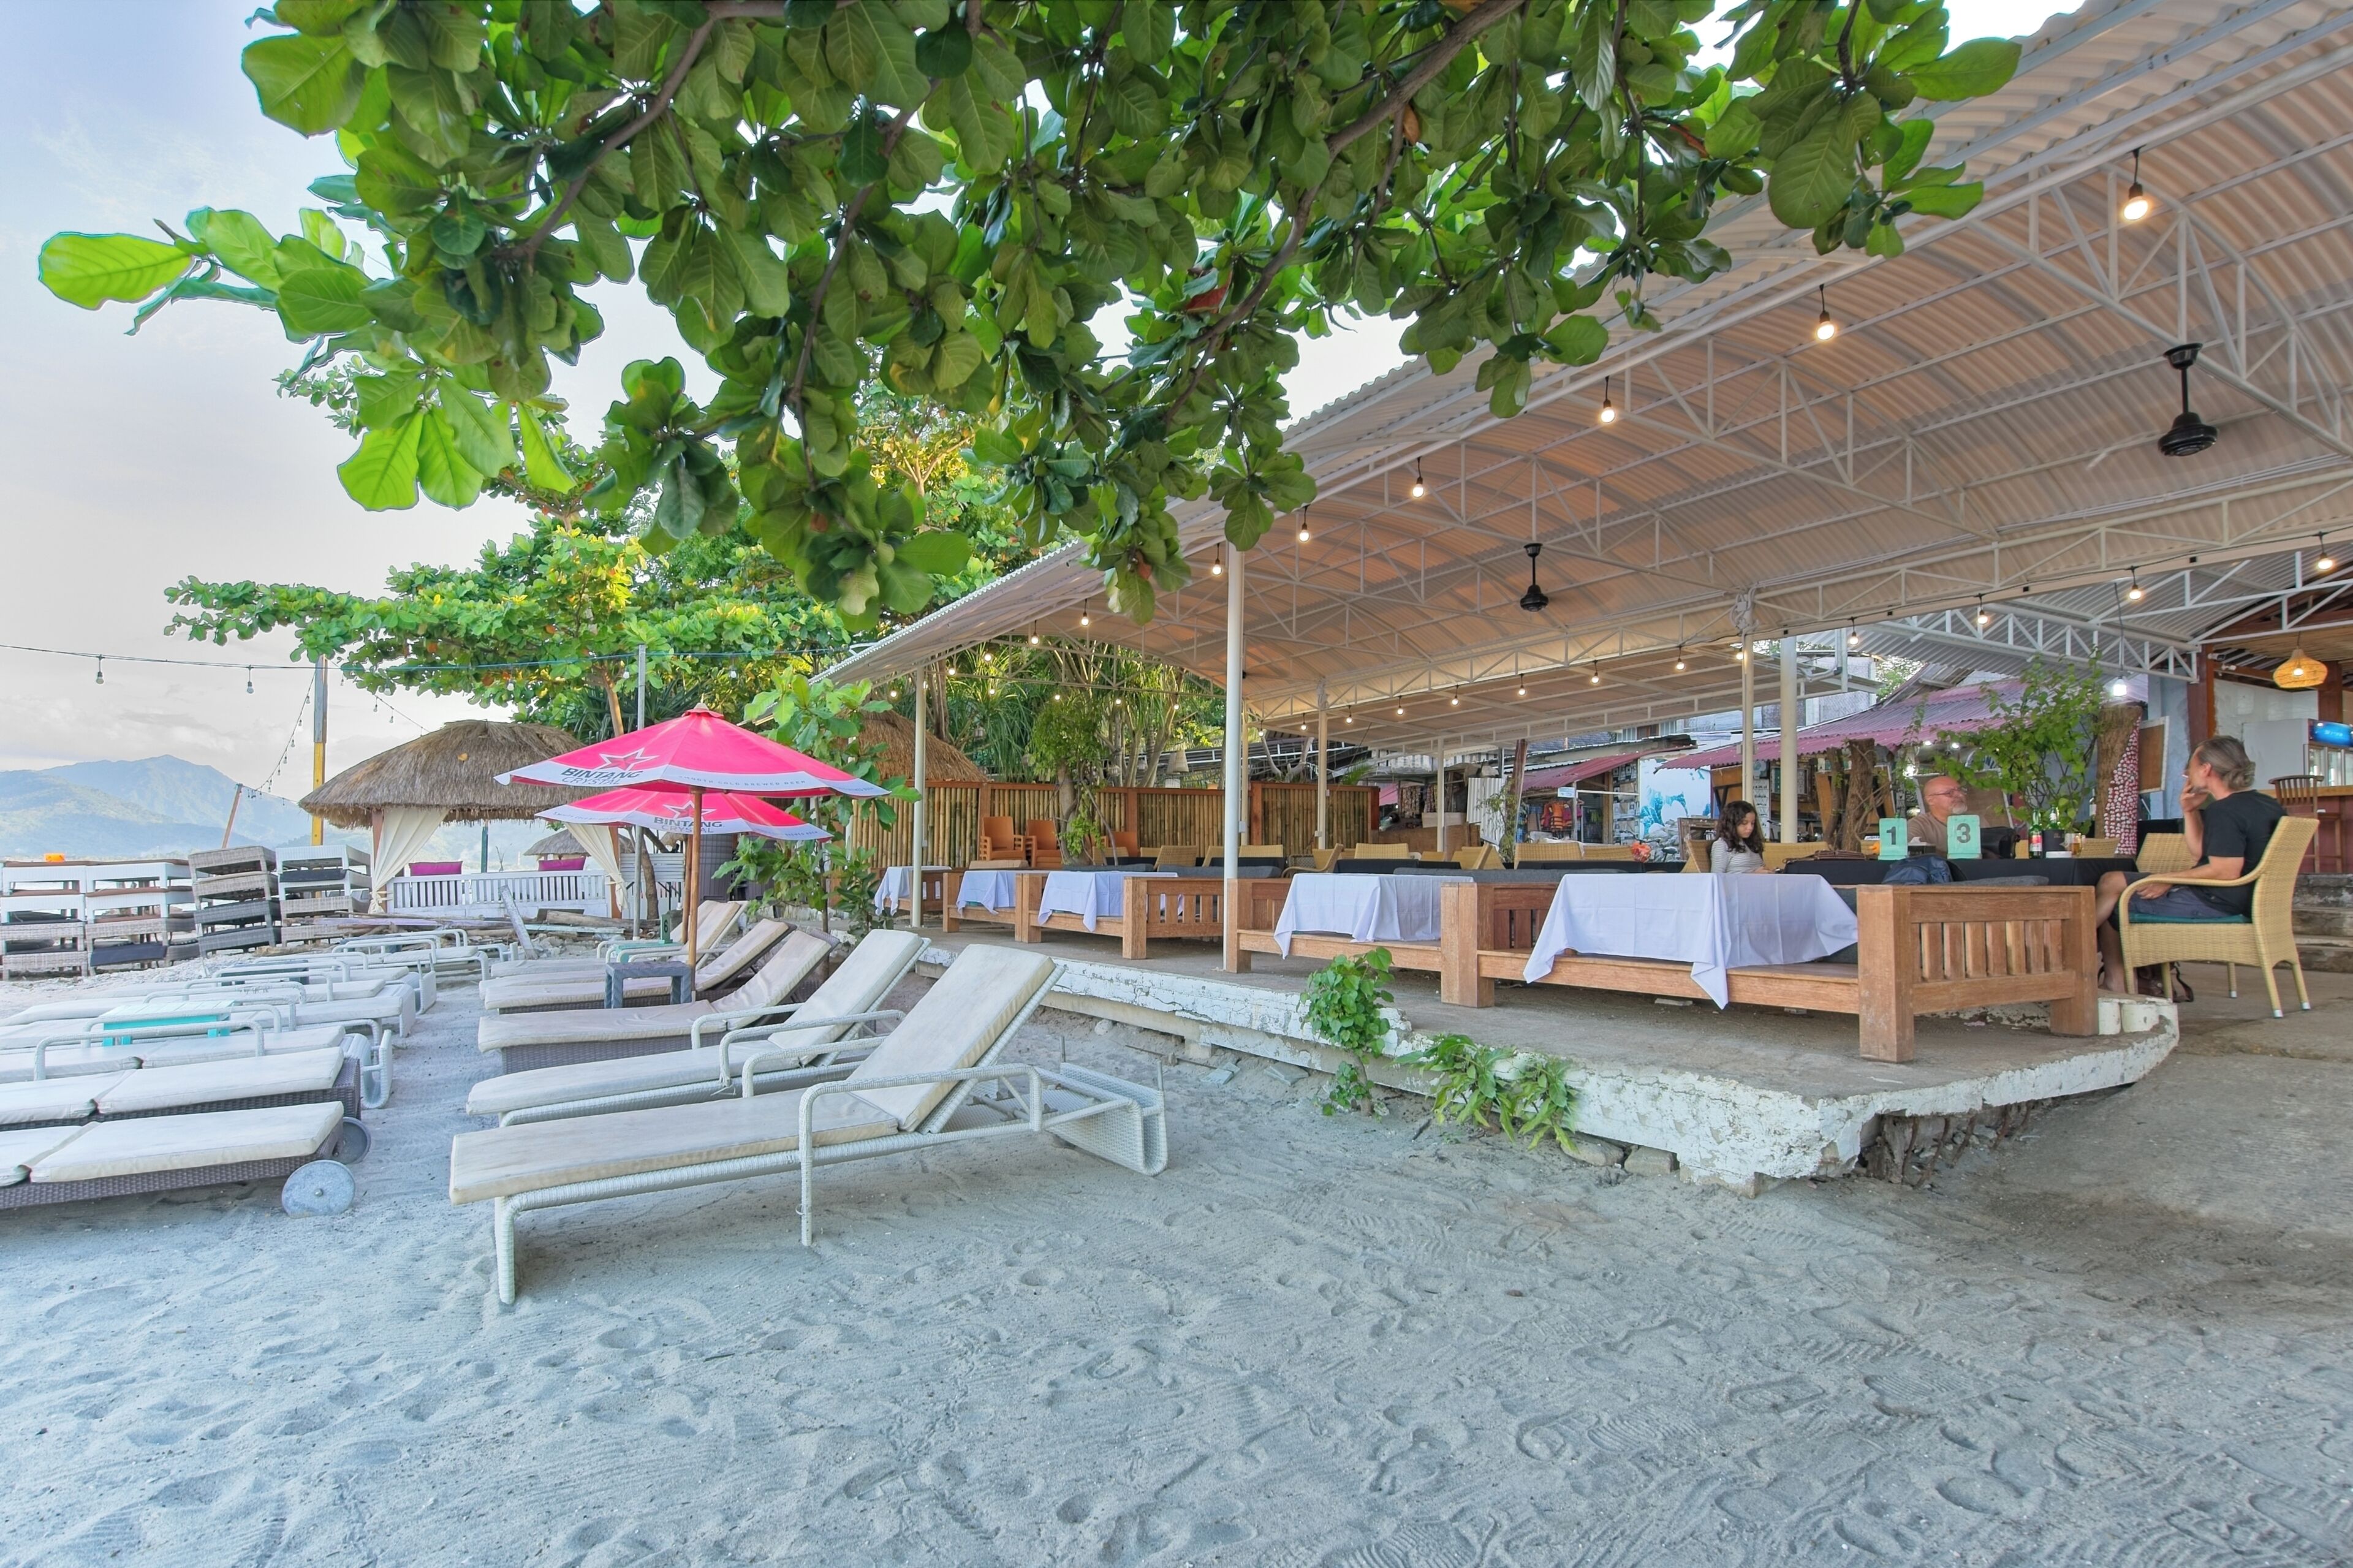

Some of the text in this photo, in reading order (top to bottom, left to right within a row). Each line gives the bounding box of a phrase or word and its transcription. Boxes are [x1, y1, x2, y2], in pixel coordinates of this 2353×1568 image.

[561, 768, 643, 779] BINTANG
[562, 776, 622, 785] CRYSTAL
[1886, 826, 1896, 845] 1
[1957, 823, 1971, 843] 3
